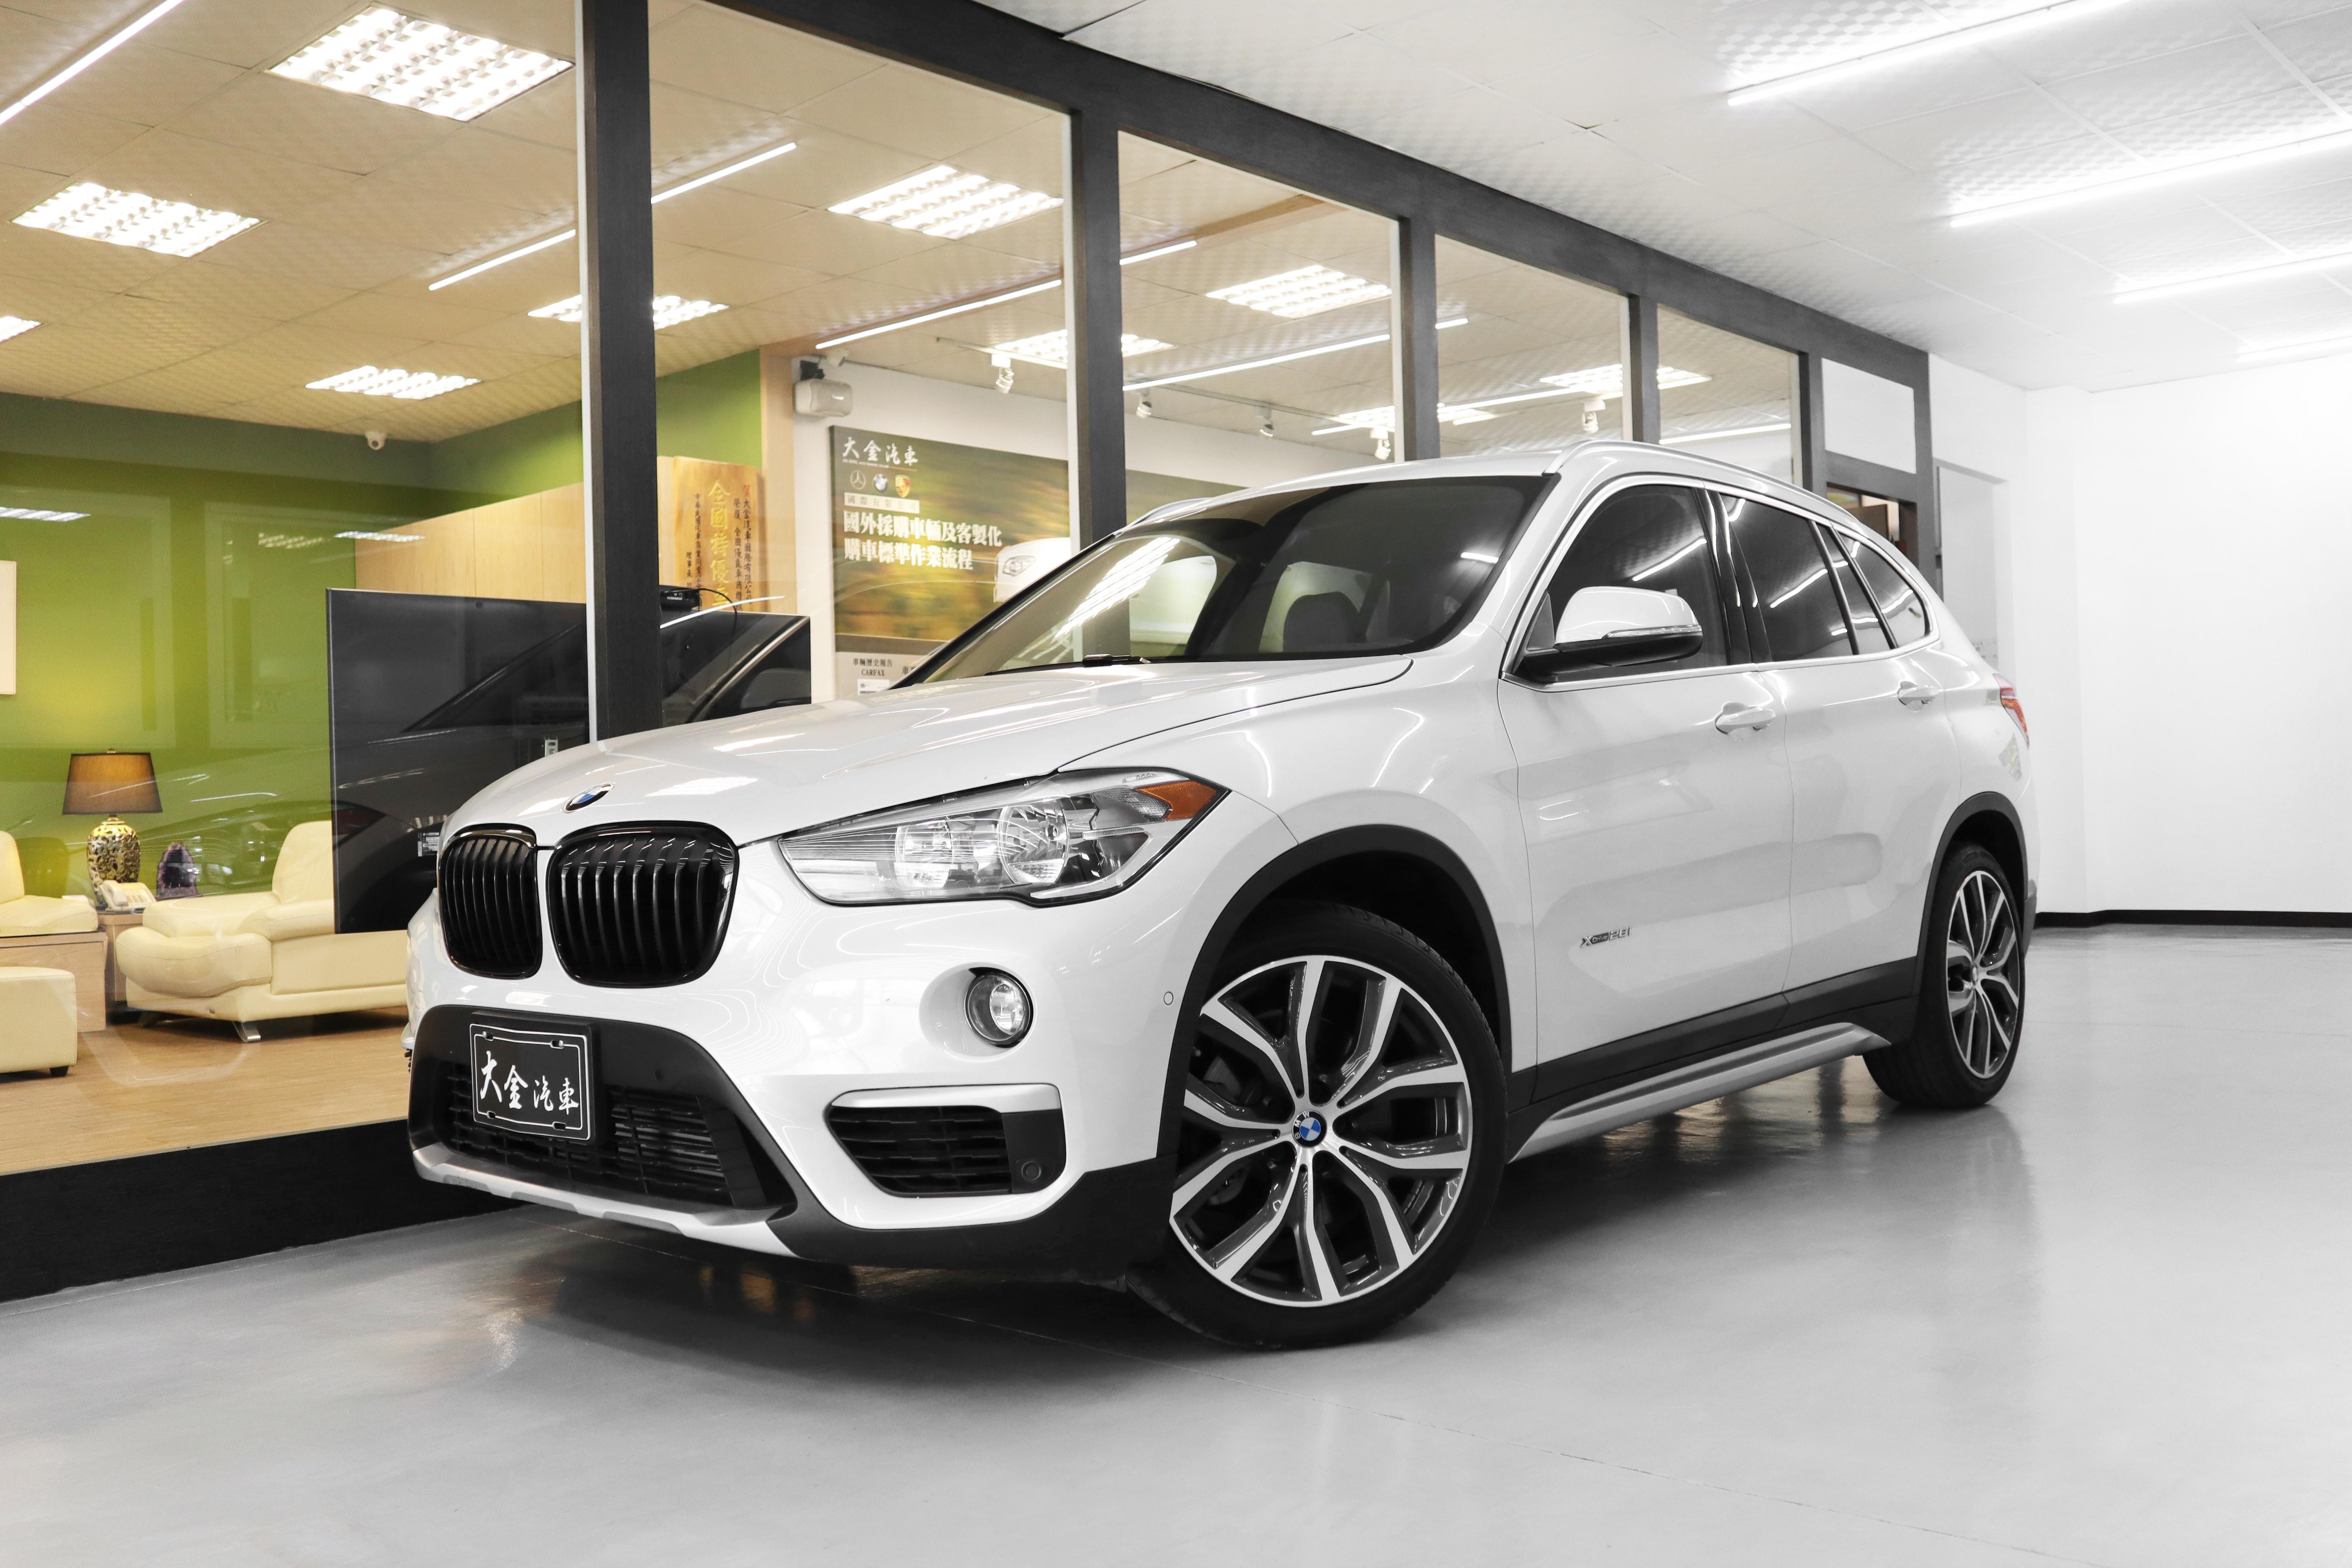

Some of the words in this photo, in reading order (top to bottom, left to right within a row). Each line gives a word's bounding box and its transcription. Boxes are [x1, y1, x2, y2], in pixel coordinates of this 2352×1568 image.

[842, 436, 918, 466] 大金汽車
[848, 495, 916, 511] 國際有限公司
[843, 510, 1003, 547] 國外採購車輛及客製化
[844, 537, 973, 570] 購車標準作業流程
[853, 657, 893, 667] 車輛歷史報告
[480, 1051, 579, 1116] 大金汽車
